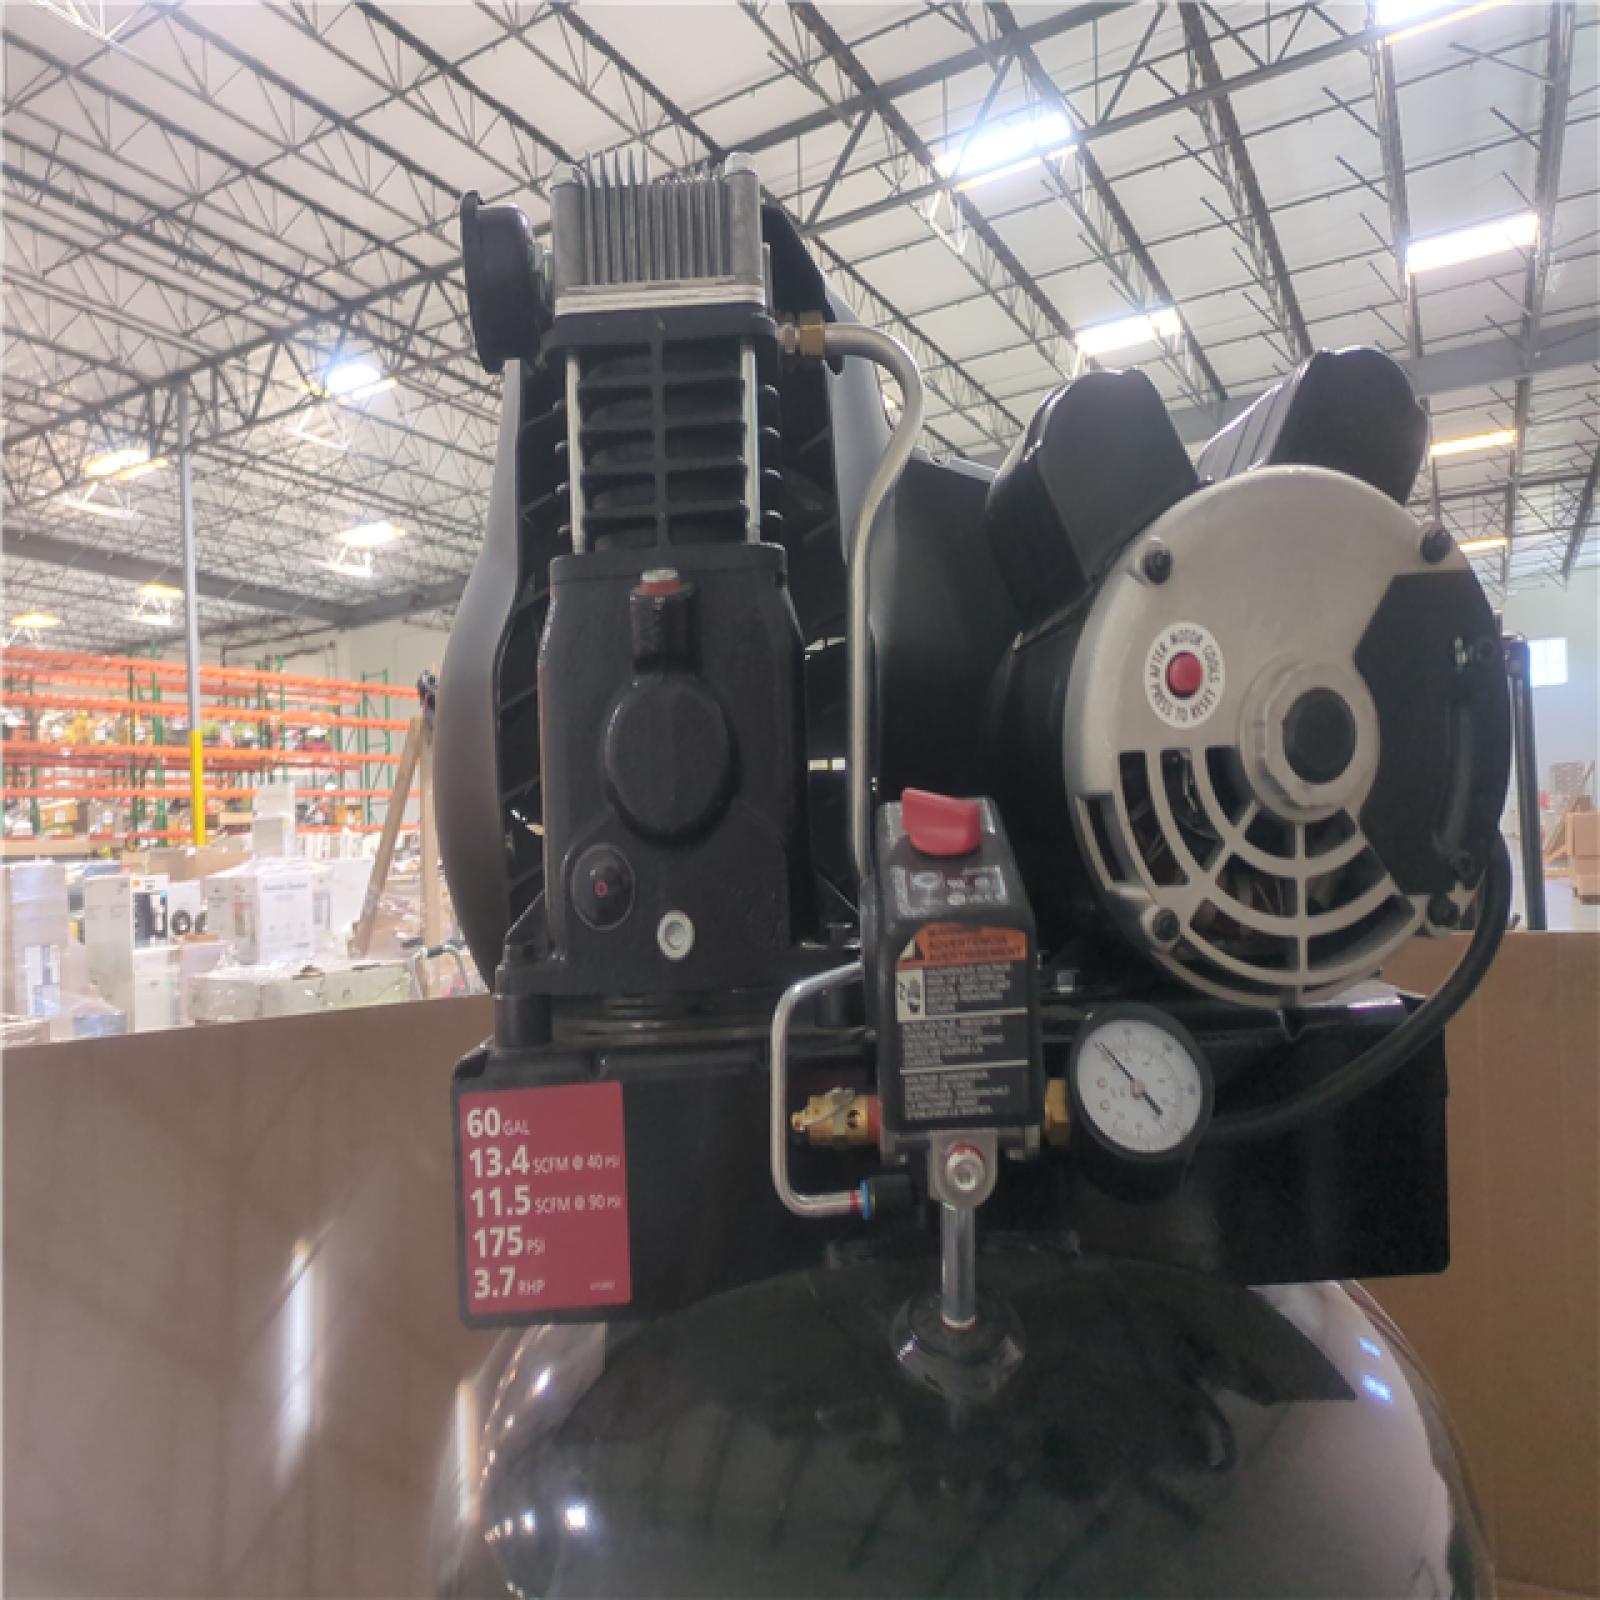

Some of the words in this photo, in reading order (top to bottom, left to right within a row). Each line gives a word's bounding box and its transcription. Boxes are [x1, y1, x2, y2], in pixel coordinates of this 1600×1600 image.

[1169, 629, 1204, 646] MOTOR
[466, 1107, 501, 1138] 60
[502, 1119, 531, 1136] GAL
[469, 1145, 530, 1179] 13.4
[532, 1155, 569, 1175] SCFM
[586, 1152, 603, 1170] 40
[604, 1154, 621, 1169] PSI
[470, 1184, 531, 1218] 11.5
[534, 1196, 571, 1215] SCFM
[588, 1193, 605, 1211] 90
[606, 1194, 622, 1209] PSI
[472, 1224, 524, 1259] 175
[526, 1238, 546, 1256] PSI
[474, 1264, 516, 1299] 3.7
[518, 1278, 546, 1296] RHP
